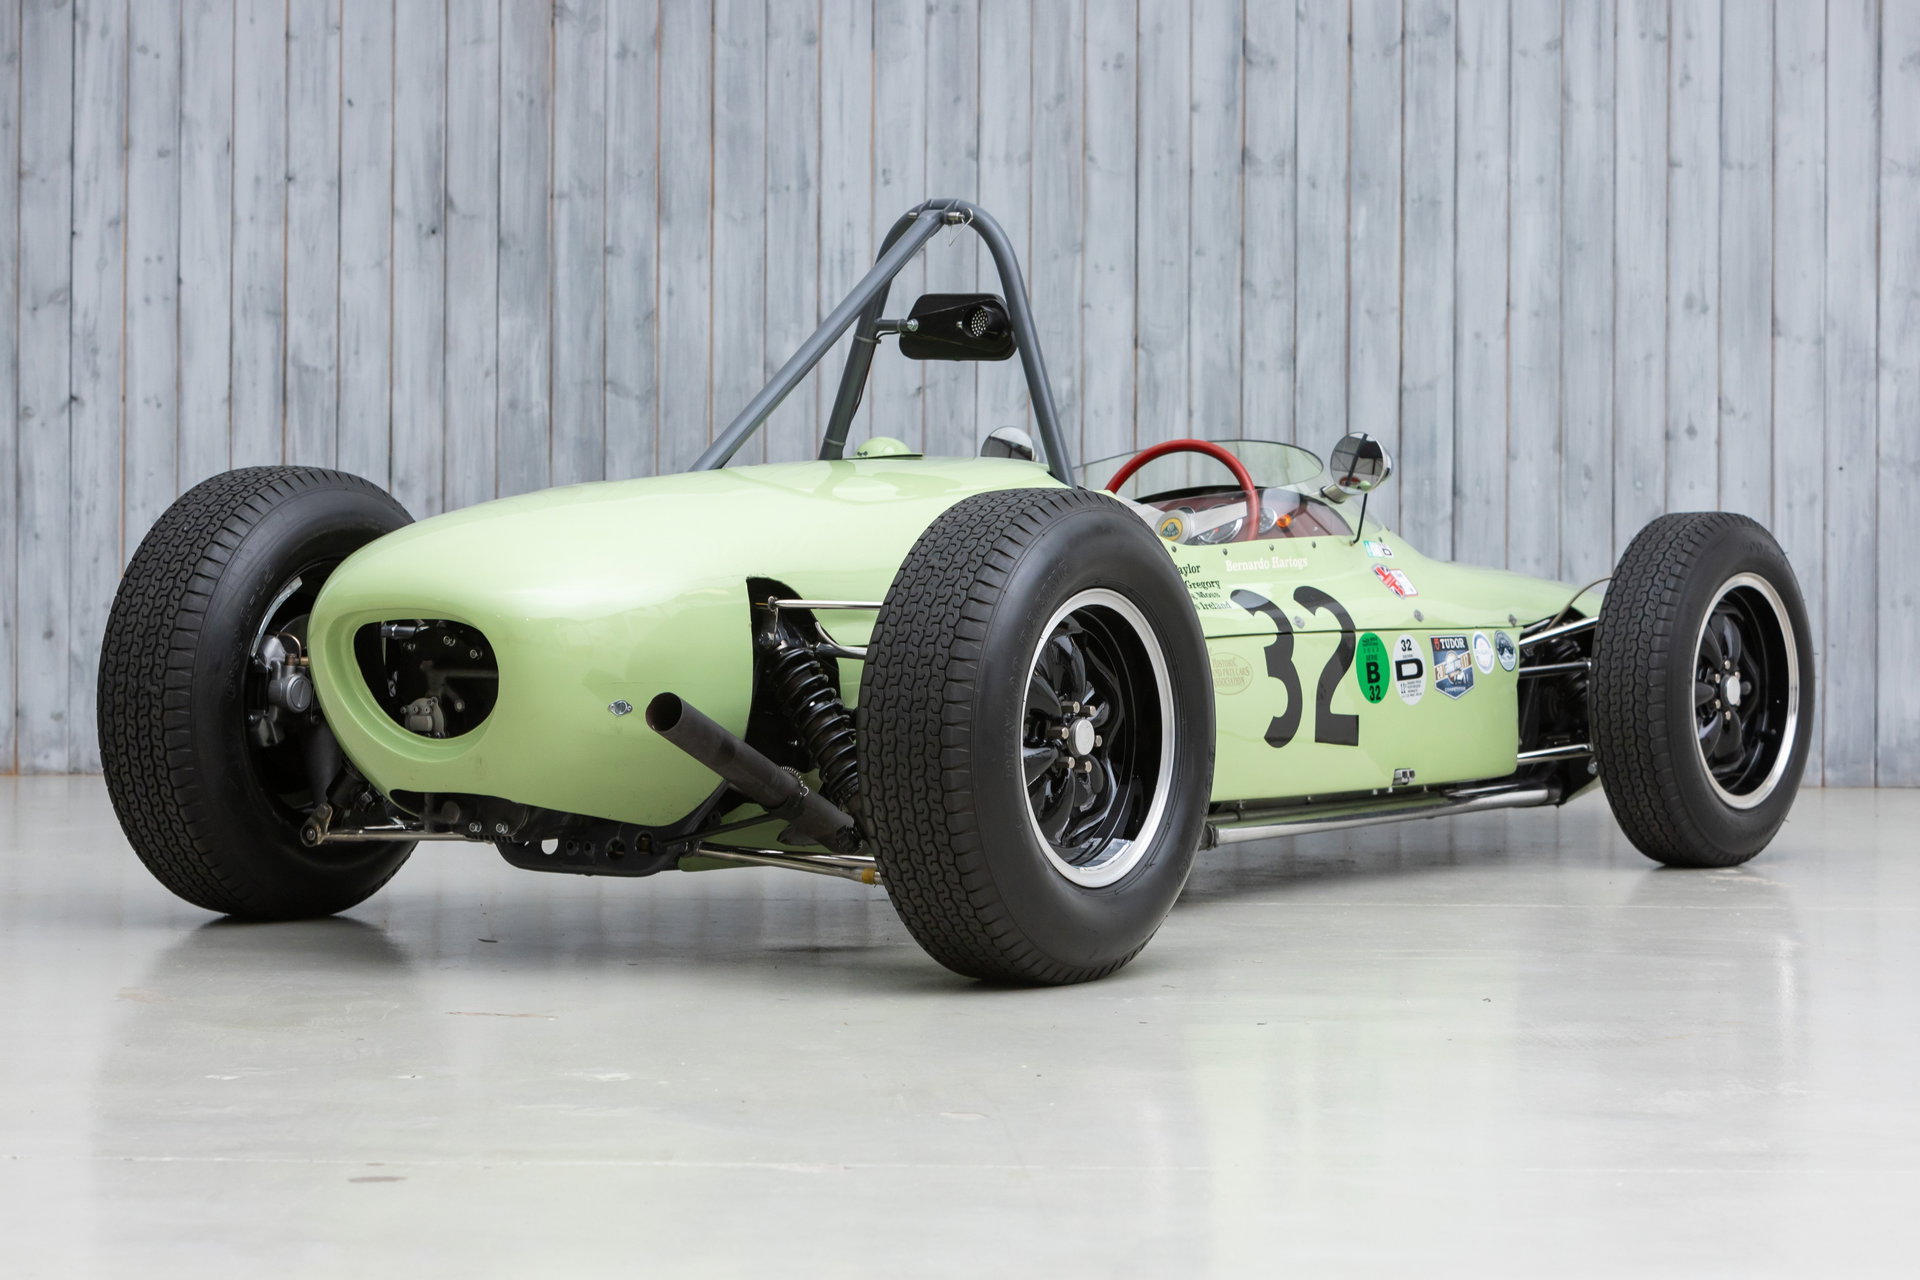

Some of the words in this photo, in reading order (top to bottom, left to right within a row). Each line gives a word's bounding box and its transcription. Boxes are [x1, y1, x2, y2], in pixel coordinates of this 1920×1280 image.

[1176, 563, 1201, 577] aylor
[1226, 558, 1269, 572] Bernardo
[1272, 556, 1308, 570] Hartogs
[1184, 579, 1221, 590] Gregory
[1200, 601, 1231, 610] Ireland
[1401, 639, 1412, 652] 32
[1440, 638, 1465, 649] TUDOR
[1230, 586, 1359, 748] 32
[1366, 662, 1381, 684] B
[1395, 657, 1423, 681] D
[1369, 685, 1381, 701] 32
